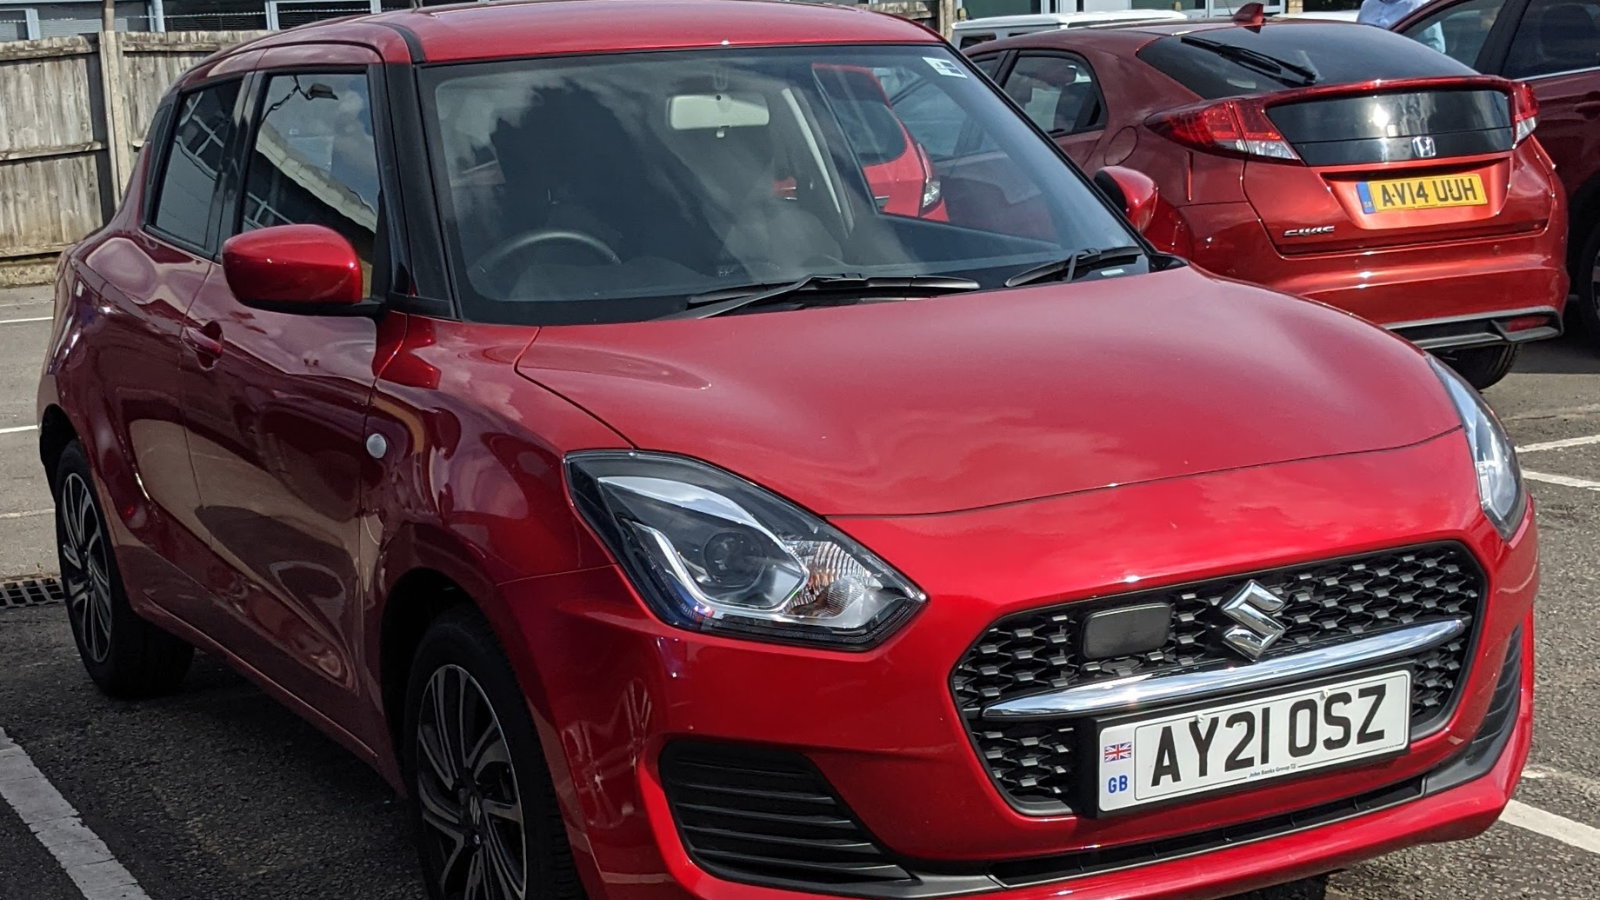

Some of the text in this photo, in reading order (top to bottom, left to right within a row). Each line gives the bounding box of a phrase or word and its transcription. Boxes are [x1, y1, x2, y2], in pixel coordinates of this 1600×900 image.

[1381, 178, 1478, 207] AV14 UUH
[1151, 684, 1386, 787] AY21 OSZ
[1108, 775, 1128, 794] GB
